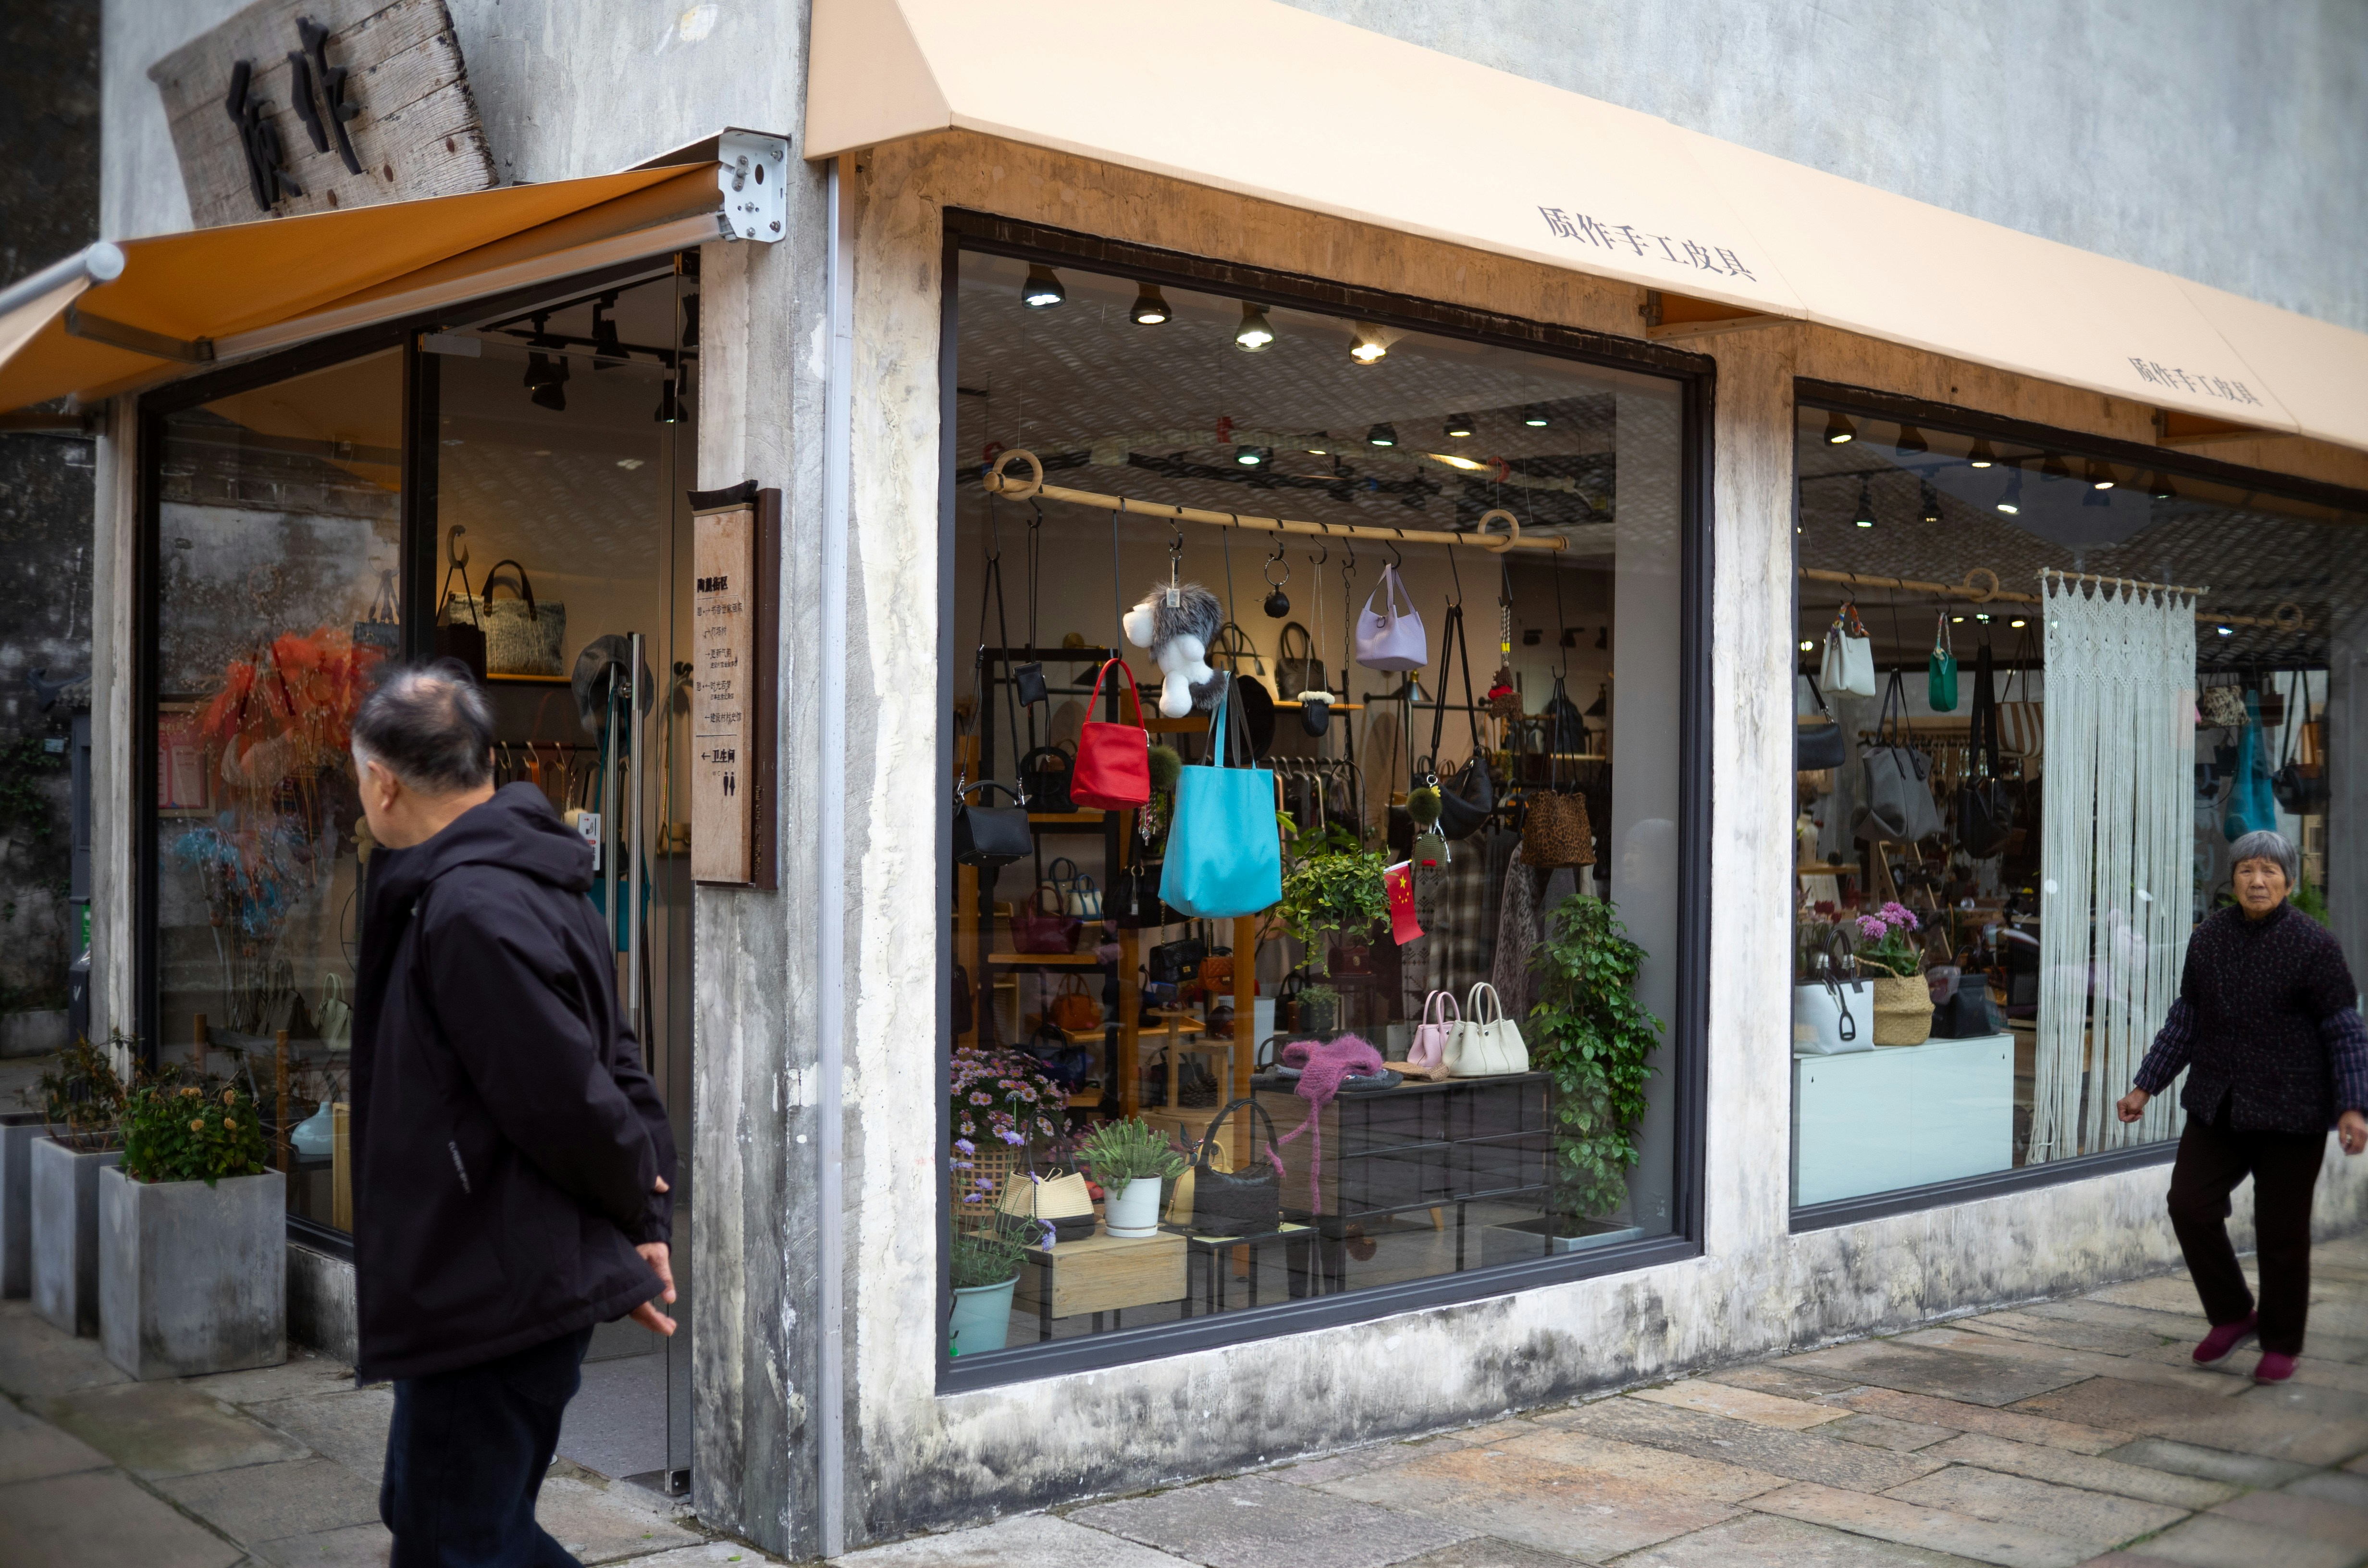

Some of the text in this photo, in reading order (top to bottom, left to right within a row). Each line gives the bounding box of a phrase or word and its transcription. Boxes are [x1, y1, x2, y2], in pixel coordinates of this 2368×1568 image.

[1537, 205, 1757, 282] 质作手工皮具
[2127, 357, 2264, 407] 质作手工皮具
[711, 748, 735, 763] 卫生间
